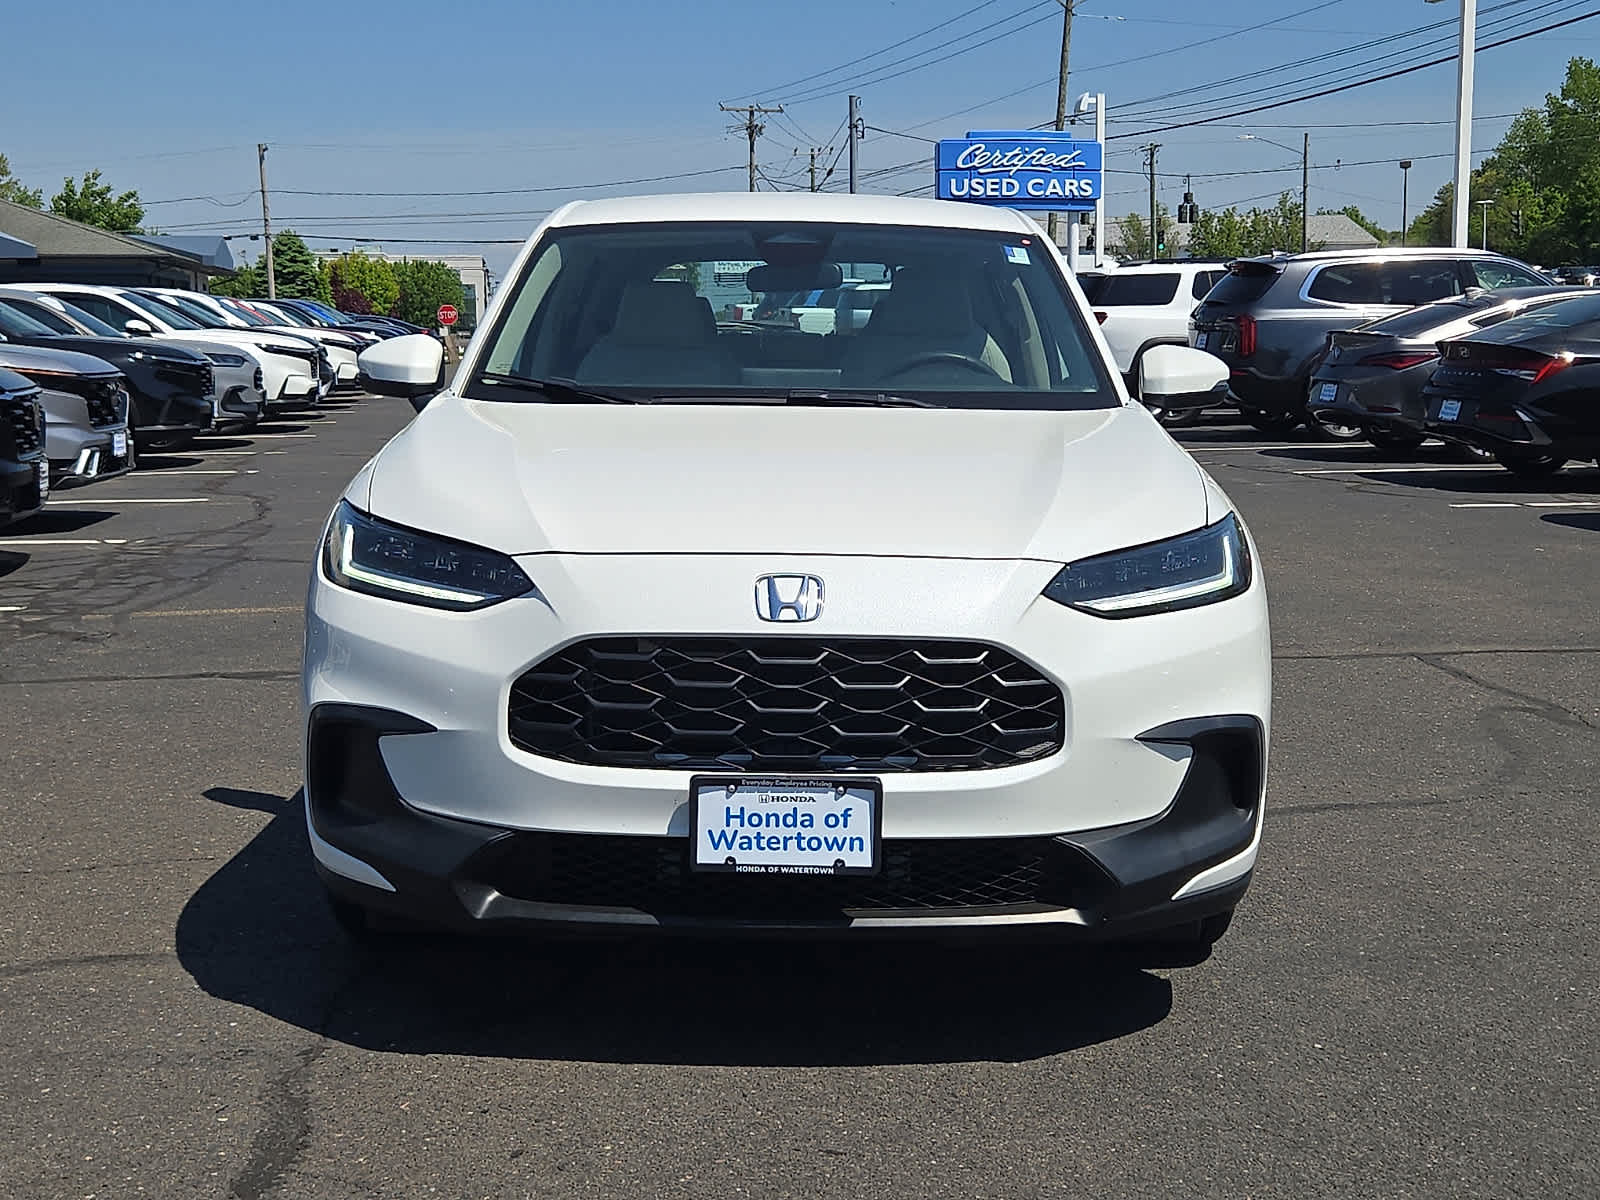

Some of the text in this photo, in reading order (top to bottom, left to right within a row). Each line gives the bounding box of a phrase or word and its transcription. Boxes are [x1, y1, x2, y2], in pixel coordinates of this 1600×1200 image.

[956, 143, 1087, 176] Certified
[950, 178, 1093, 197] USED CARS
[440, 311, 457, 320] STOP
[808, 780, 833, 789] Pricing
[771, 795, 817, 803] HONDA
[725, 806, 853, 829] Honda of
[707, 829, 864, 852] Watertown
[735, 865, 766, 873] HONDA
[780, 866, 834, 875] WATERTOWN
